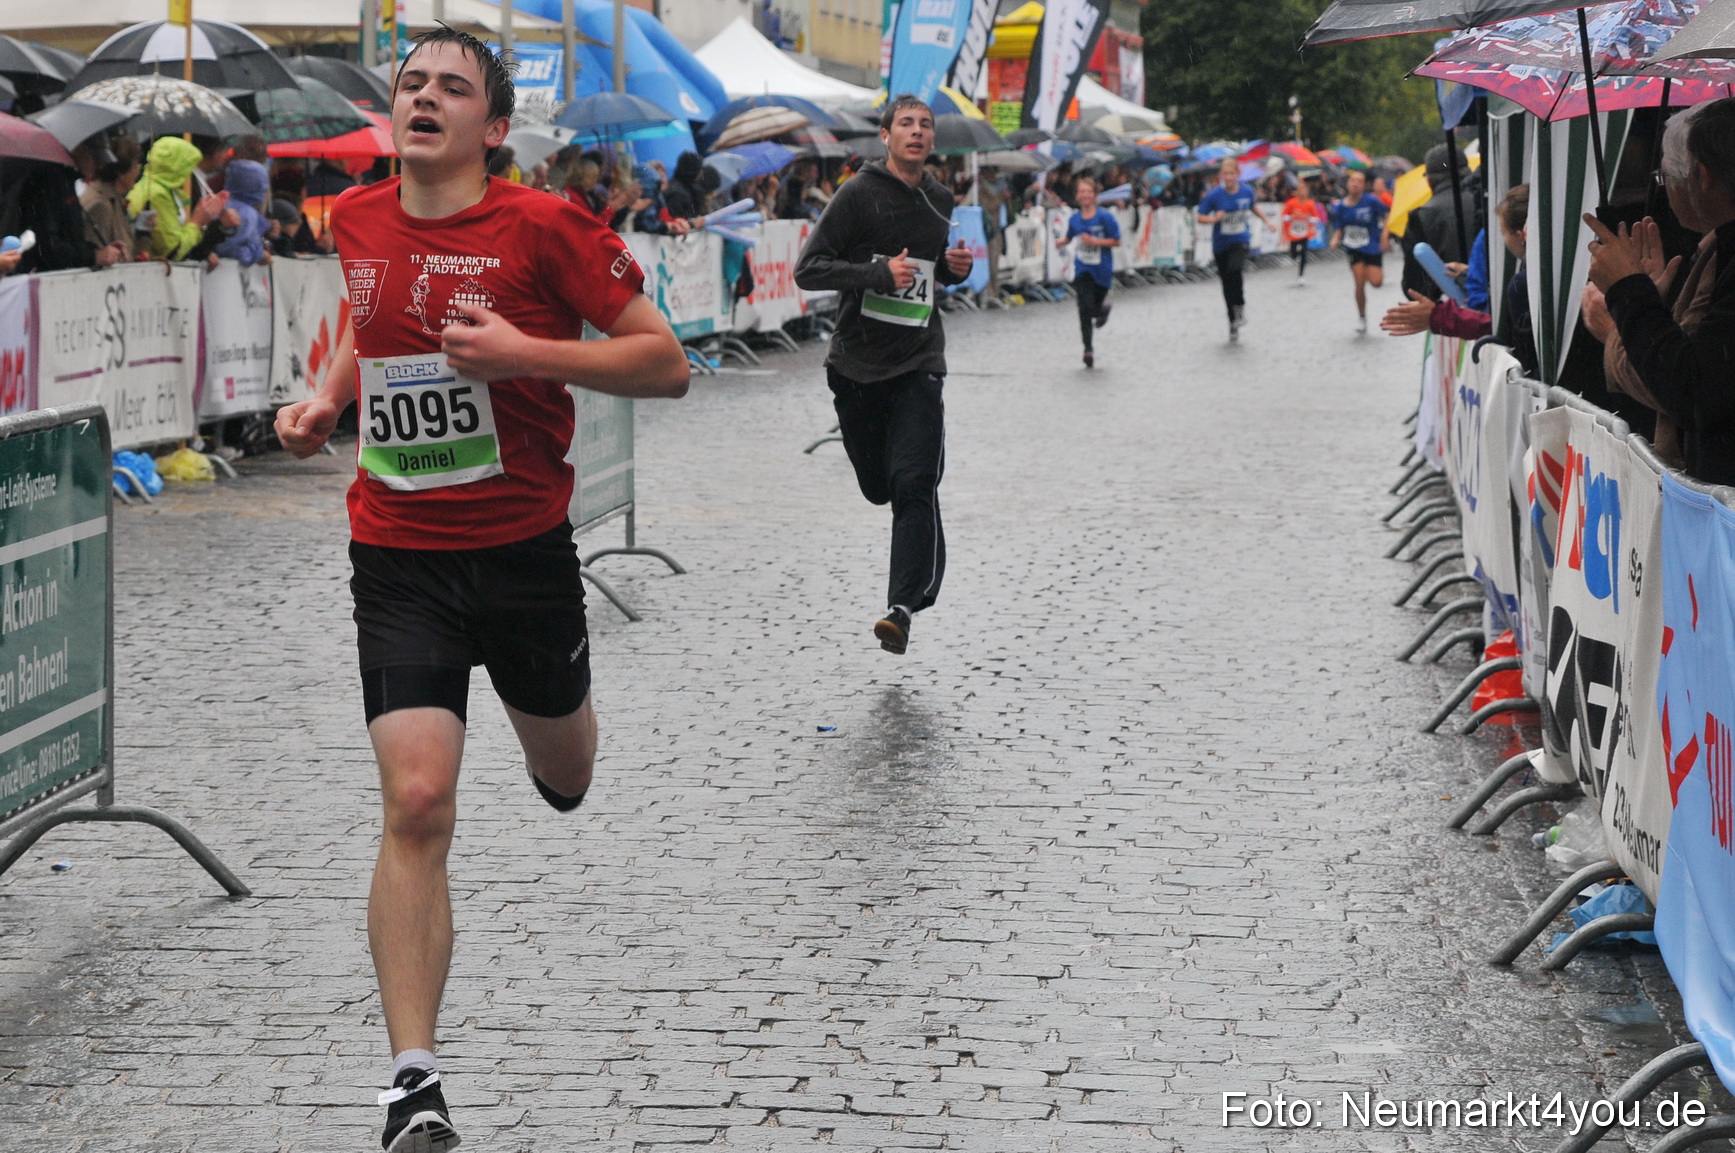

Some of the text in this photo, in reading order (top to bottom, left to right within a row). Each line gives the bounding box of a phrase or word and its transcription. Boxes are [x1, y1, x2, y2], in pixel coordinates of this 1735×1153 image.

[410, 254, 500, 268] 11. NEUMARKTER
[422, 264, 484, 276] STADTLAUF
[349, 268, 376, 279] IMMER
[351, 289, 371, 305] NEU
[385, 362, 438, 379] BOCK
[369, 386, 480, 443] 5095
[398, 448, 455, 473] Daniel
[2, 567, 58, 635] Action in
[18, 636, 68, 704] Bahnen!
[62, 731, 80, 768] 6352
